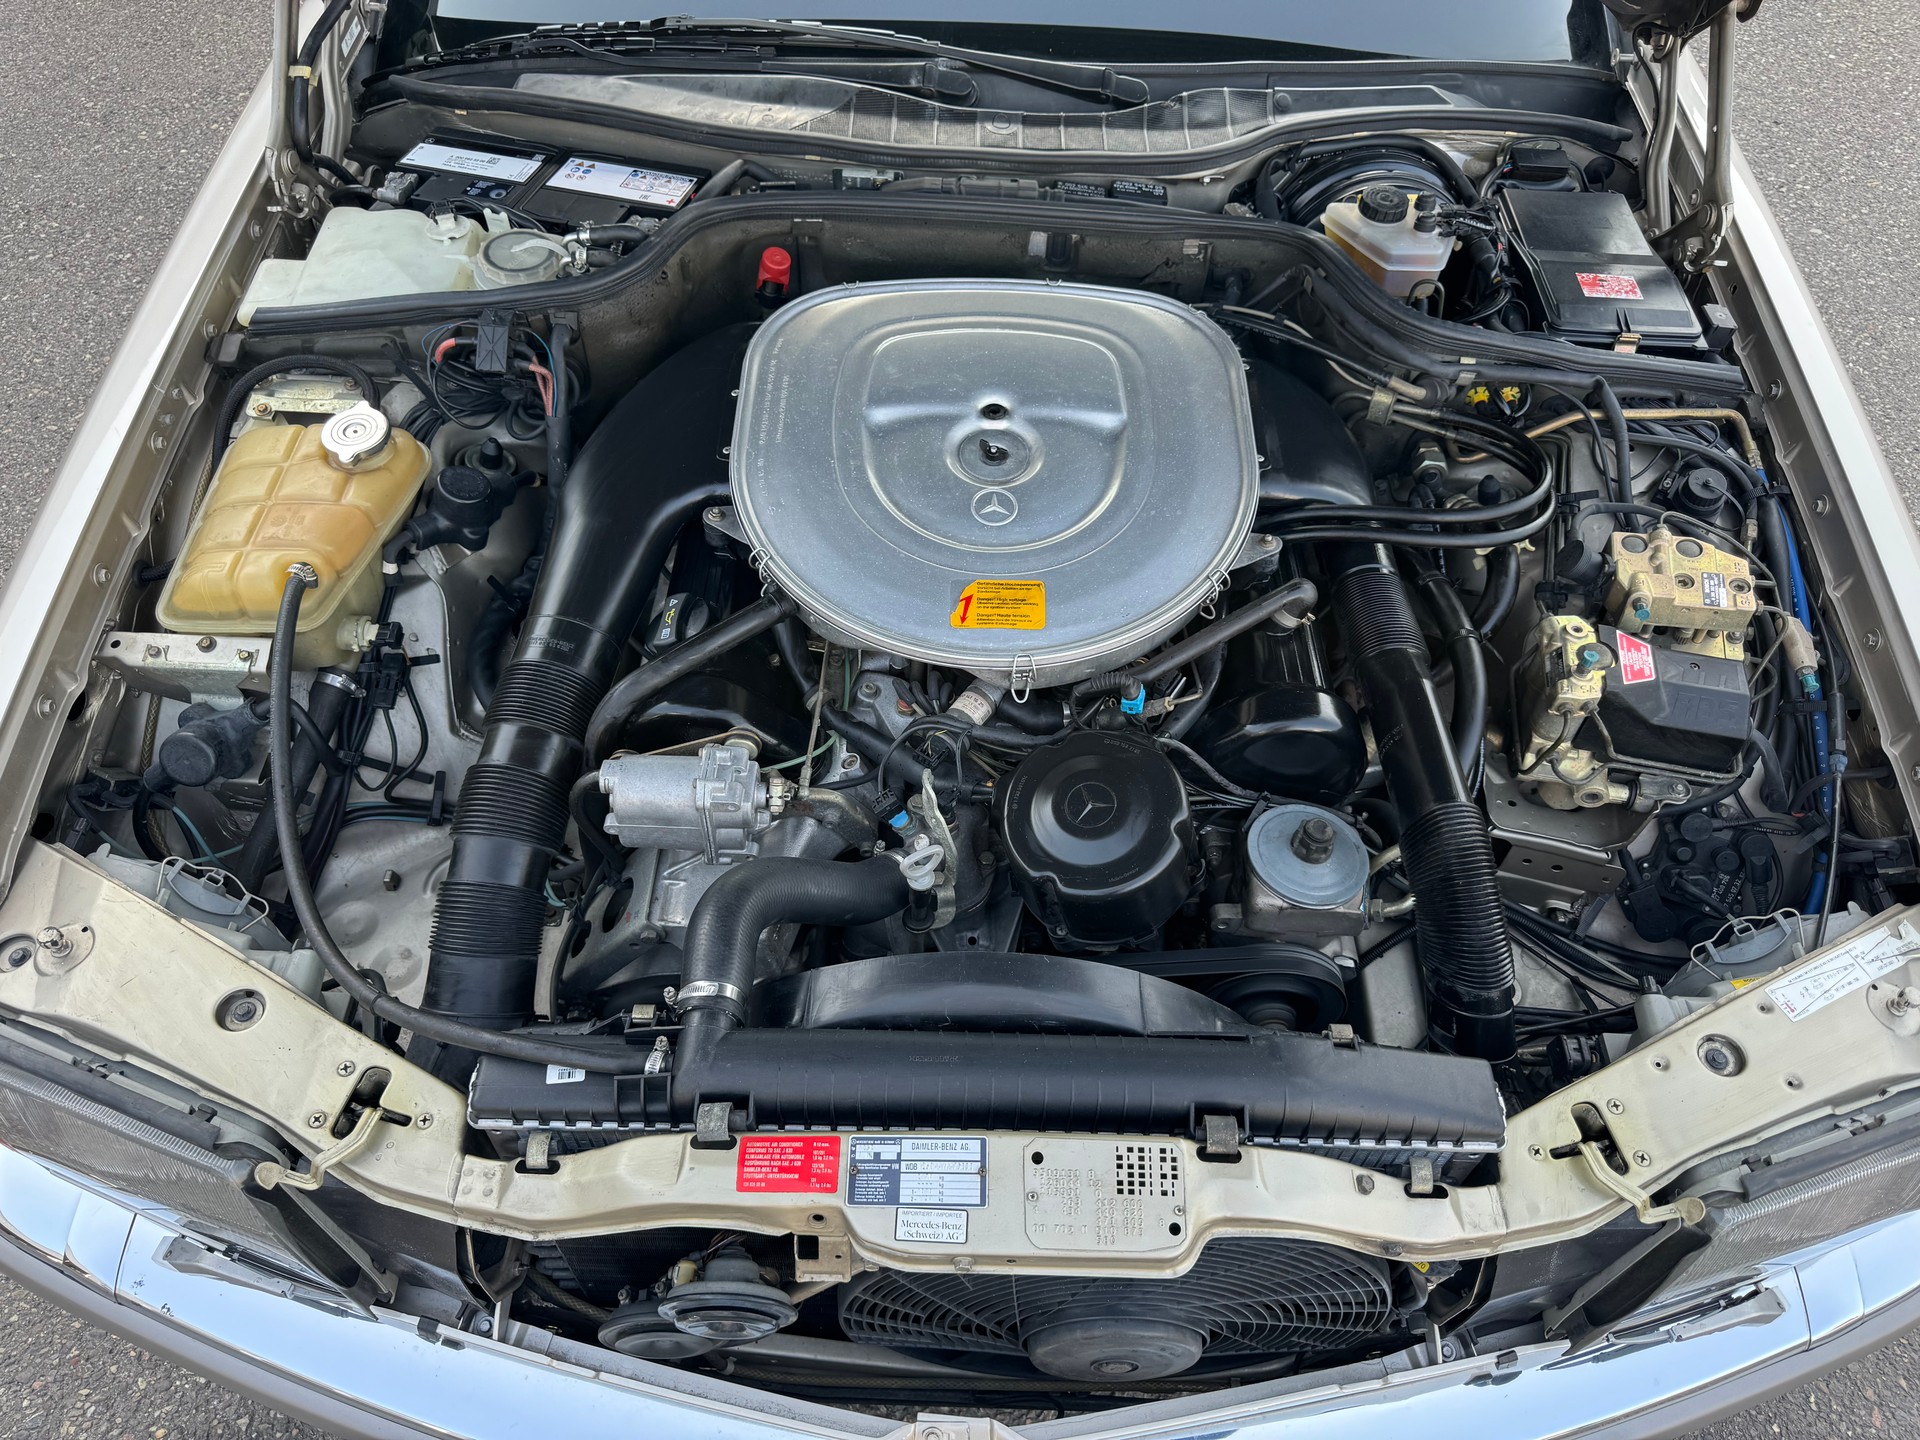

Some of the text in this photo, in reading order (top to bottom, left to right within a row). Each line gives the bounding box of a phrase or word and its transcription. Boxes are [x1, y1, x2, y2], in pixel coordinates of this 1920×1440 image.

[912, 1142, 958, 1150] DAIMLER-BENZ
[905, 1162, 918, 1170] WDB
[901, 1220, 962, 1230] Mercedes-Benz
[904, 1230, 958, 1240] (Schweiz) AG
